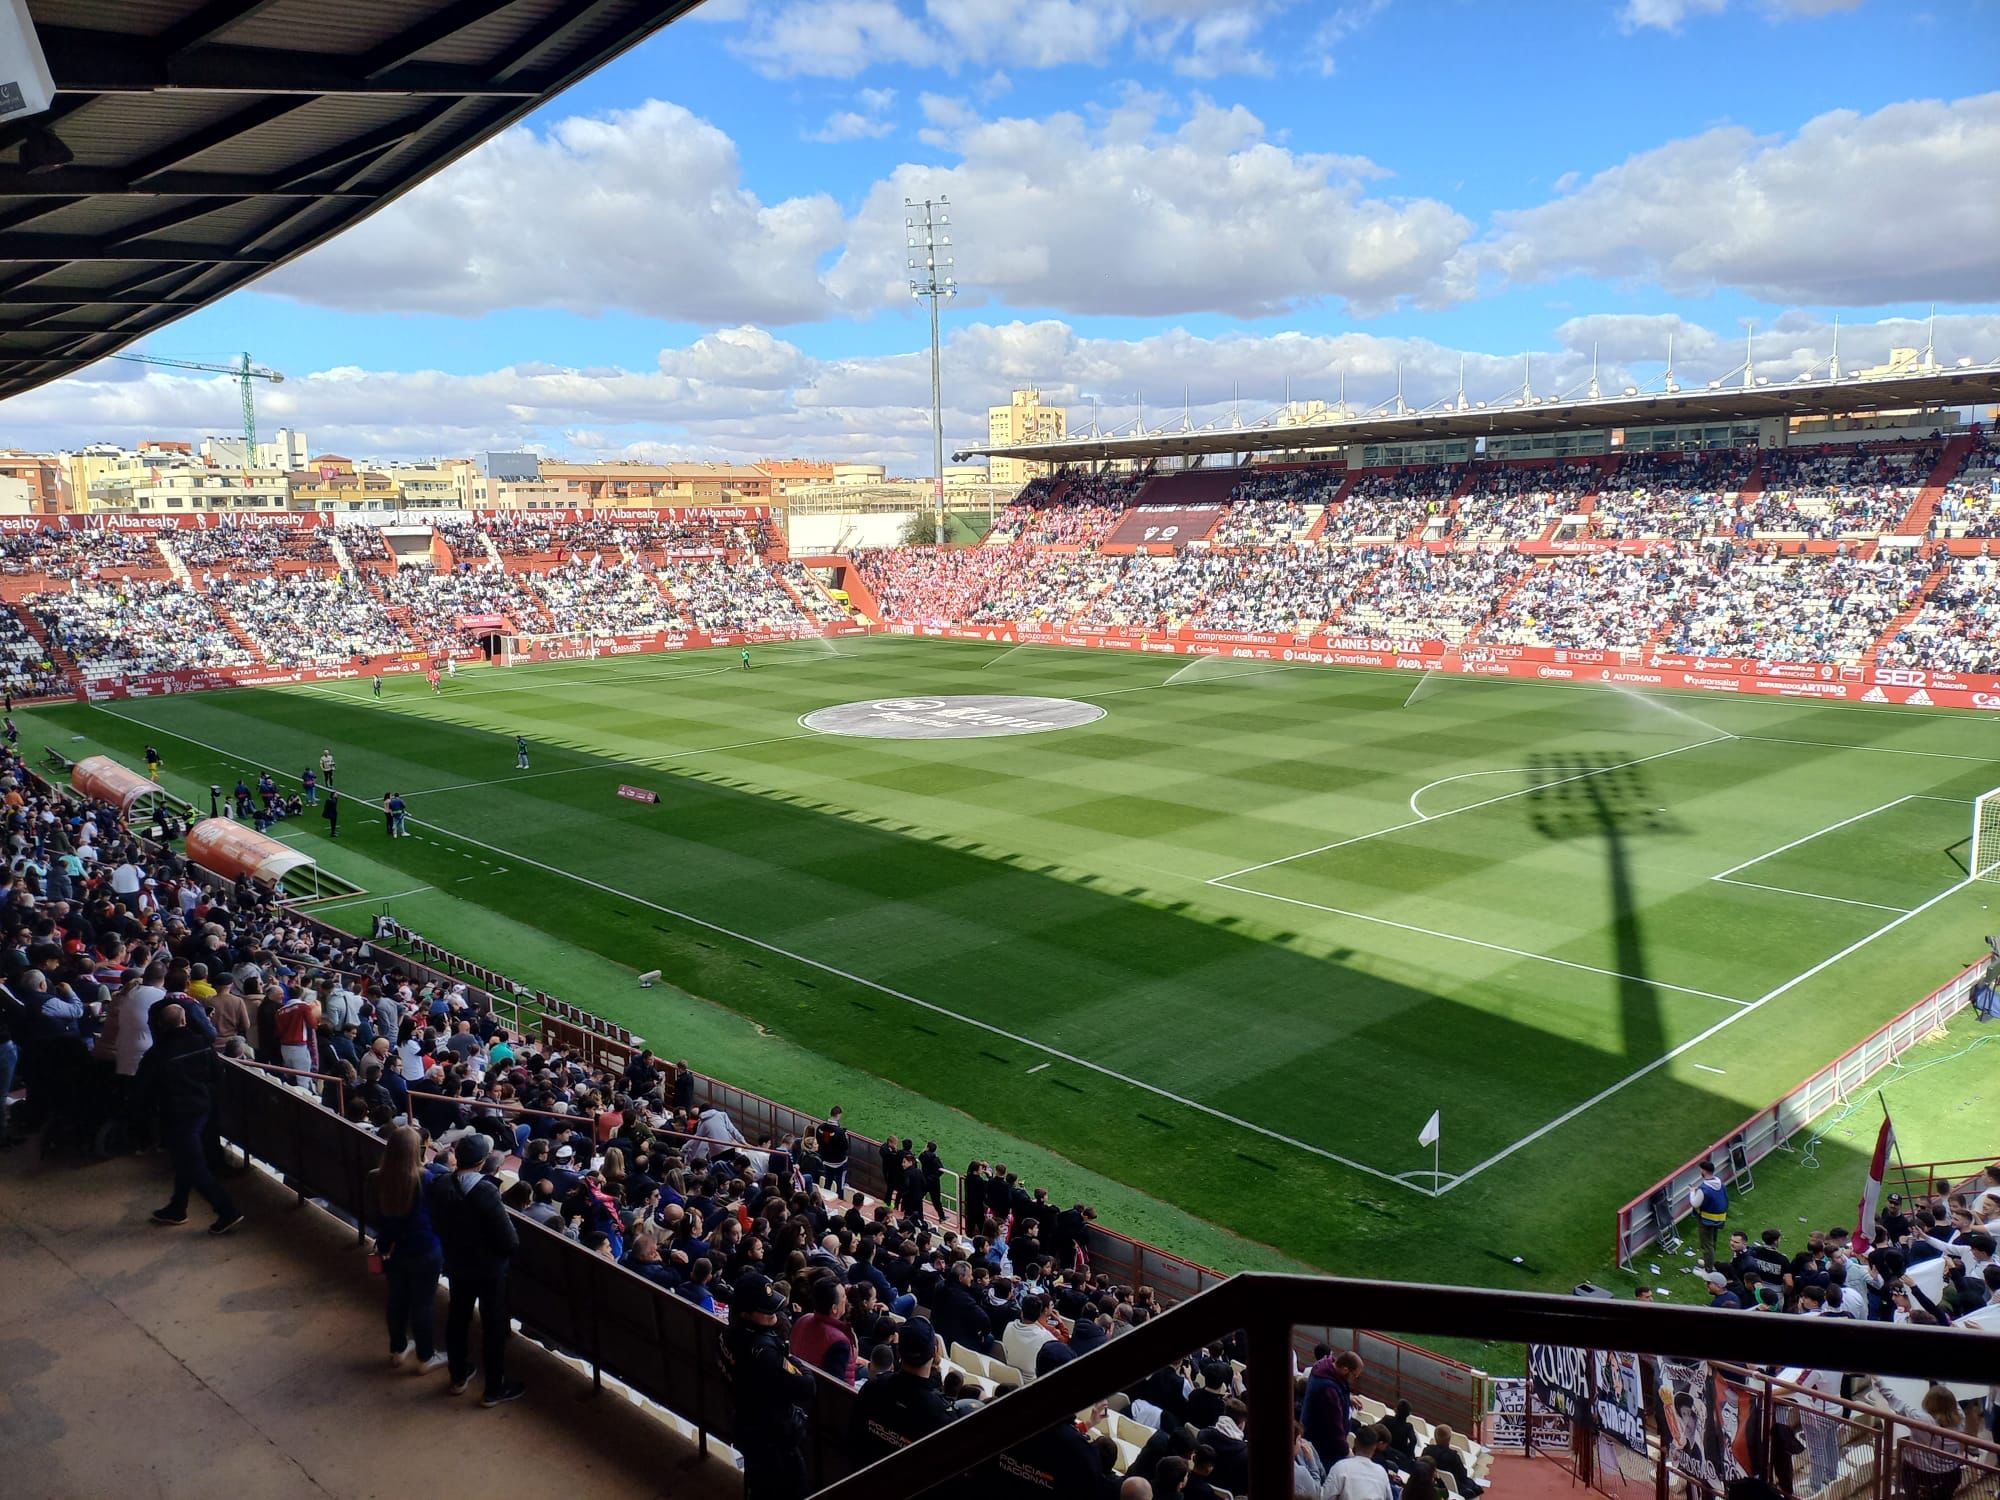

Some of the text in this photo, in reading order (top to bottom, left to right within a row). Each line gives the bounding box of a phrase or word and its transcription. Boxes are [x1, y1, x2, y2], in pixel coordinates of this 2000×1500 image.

[240, 512, 304, 526] Albarealty
[610, 509, 660, 520] Albarealty
[700, 508, 747, 519] Albarealty
[108, 515, 179, 530] Albarealty
[1194, 632, 1277, 644] compresoresalfaro.es
[1327, 638, 1370, 650] CARNES
[548, 648, 600, 660] CALIMAR
[1294, 651, 1383, 666] LaLiga SmartBank
[1874, 668, 1927, 687] SER
[1932, 672, 1957, 681] Radio
[1932, 682, 1968, 690] Albacete
[1000, 1454, 1041, 1477] POLICIA
[1000, 1461, 1054, 1490] NACIONAL
